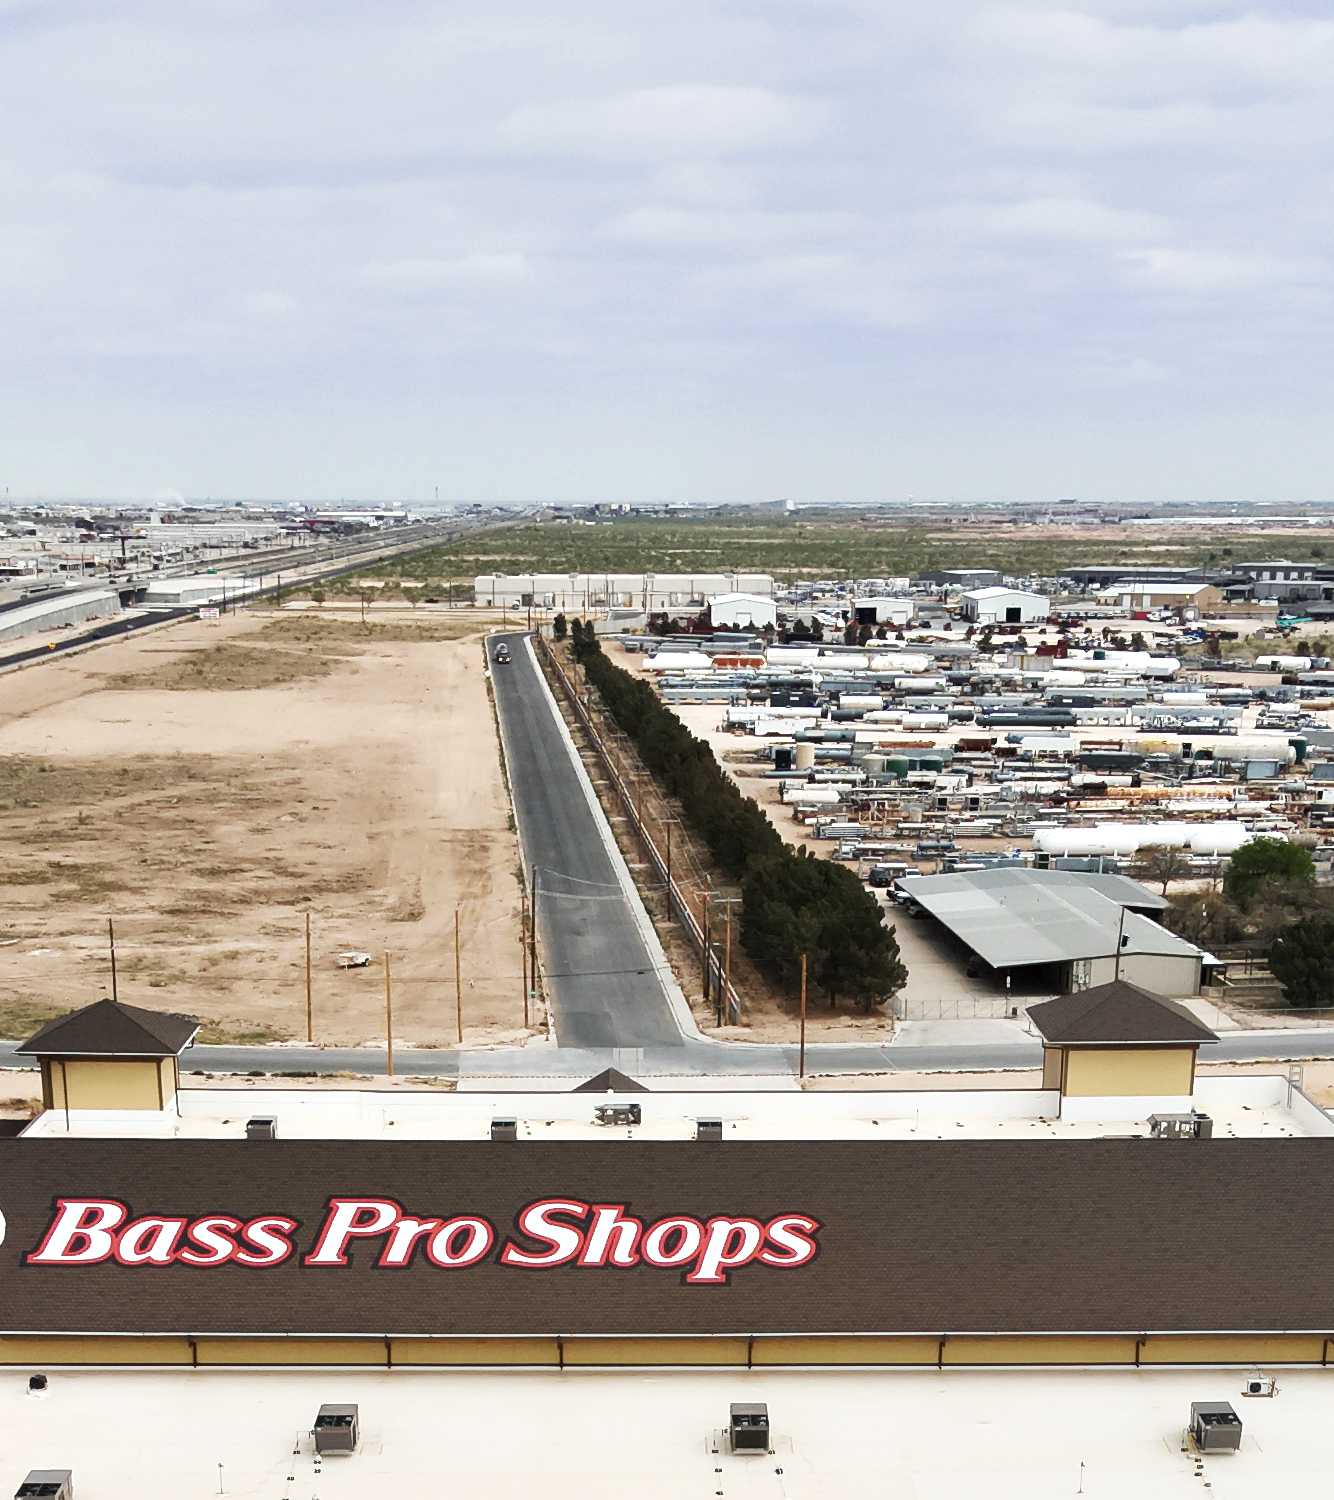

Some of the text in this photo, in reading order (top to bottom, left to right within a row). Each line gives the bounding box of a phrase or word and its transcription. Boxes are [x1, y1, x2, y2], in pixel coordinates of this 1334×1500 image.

[27, 1198, 820, 1283] Bass Pro Shops
